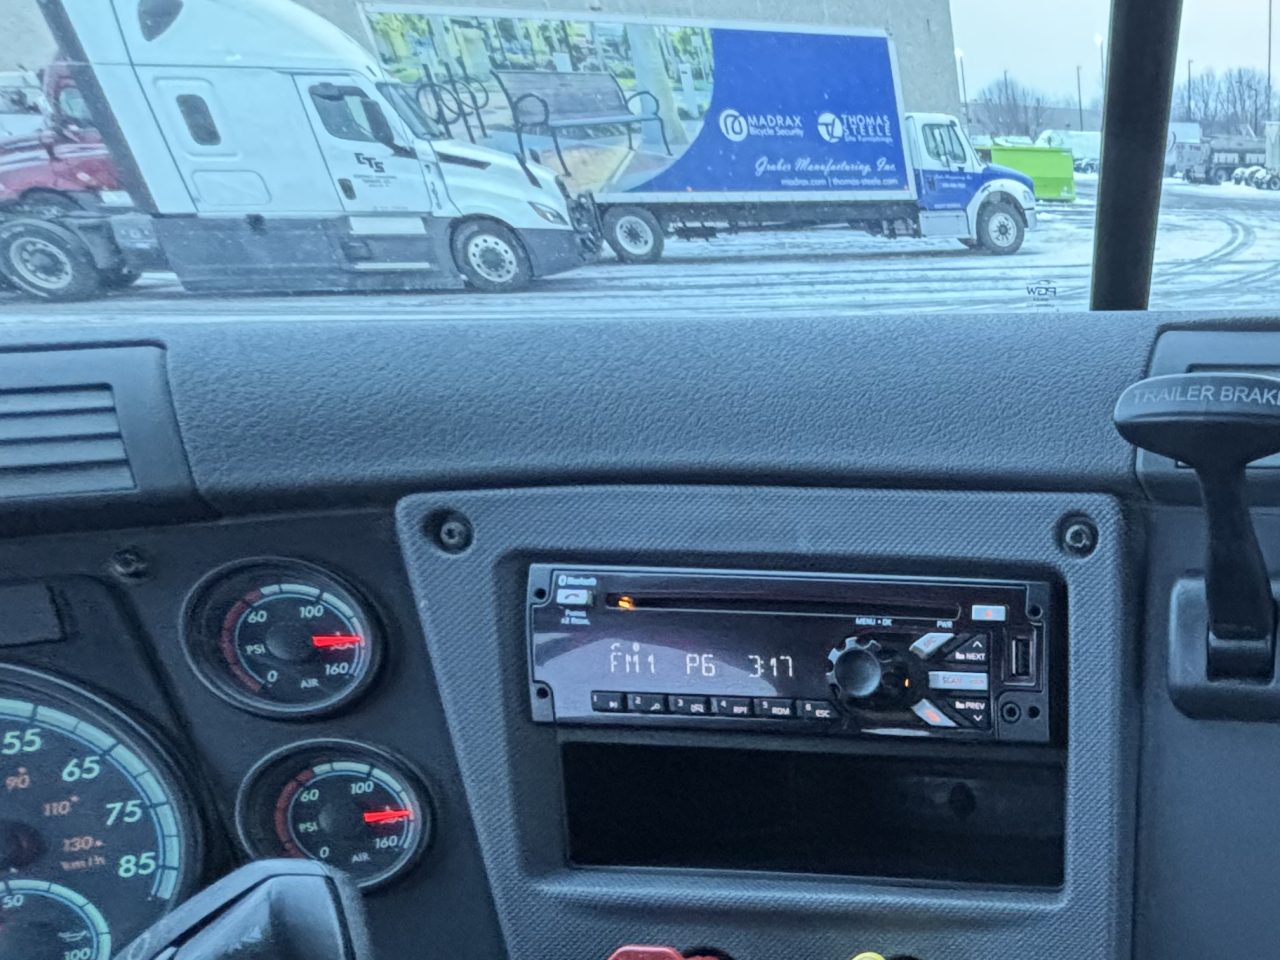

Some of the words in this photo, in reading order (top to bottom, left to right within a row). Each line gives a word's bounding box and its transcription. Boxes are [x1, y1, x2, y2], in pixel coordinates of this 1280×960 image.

[749, 114, 802, 127] MADRAX
[841, 114, 889, 126] THOMAS
[750, 126, 775, 136] Bicycle
[776, 127, 804, 138] Security
[843, 125, 892, 136] STEELE
[1133, 386, 1215, 403] TRAILER
[248, 610, 267, 623] 60
[300, 605, 324, 618] 100
[856, 617, 876, 626] MENU
[245, 643, 266, 655] PSI
[966, 652, 986, 660] NEXT
[325, 662, 349, 676] 160
[686, 653, 716, 677] P6
[748, 655, 793, 678] 3:17
[267, 670, 278, 682] 0
[300, 678, 319, 688] AIR
[635, 696, 641, 704] 2
[677, 698, 684, 707] 3
[720, 700, 727, 708] 4
[762, 701, 768, 709] 5
[966, 701, 986, 710] PREV
[1, 728, 42, 755] 55
[62, 755, 100, 782] 65
[6, 774, 30, 791] 90
[43, 801, 70, 816] 110
[106, 800, 142, 826] 75
[63, 836, 94, 851] 130
[118, 852, 156, 878] 85
[3, 894, 24, 909] 50
